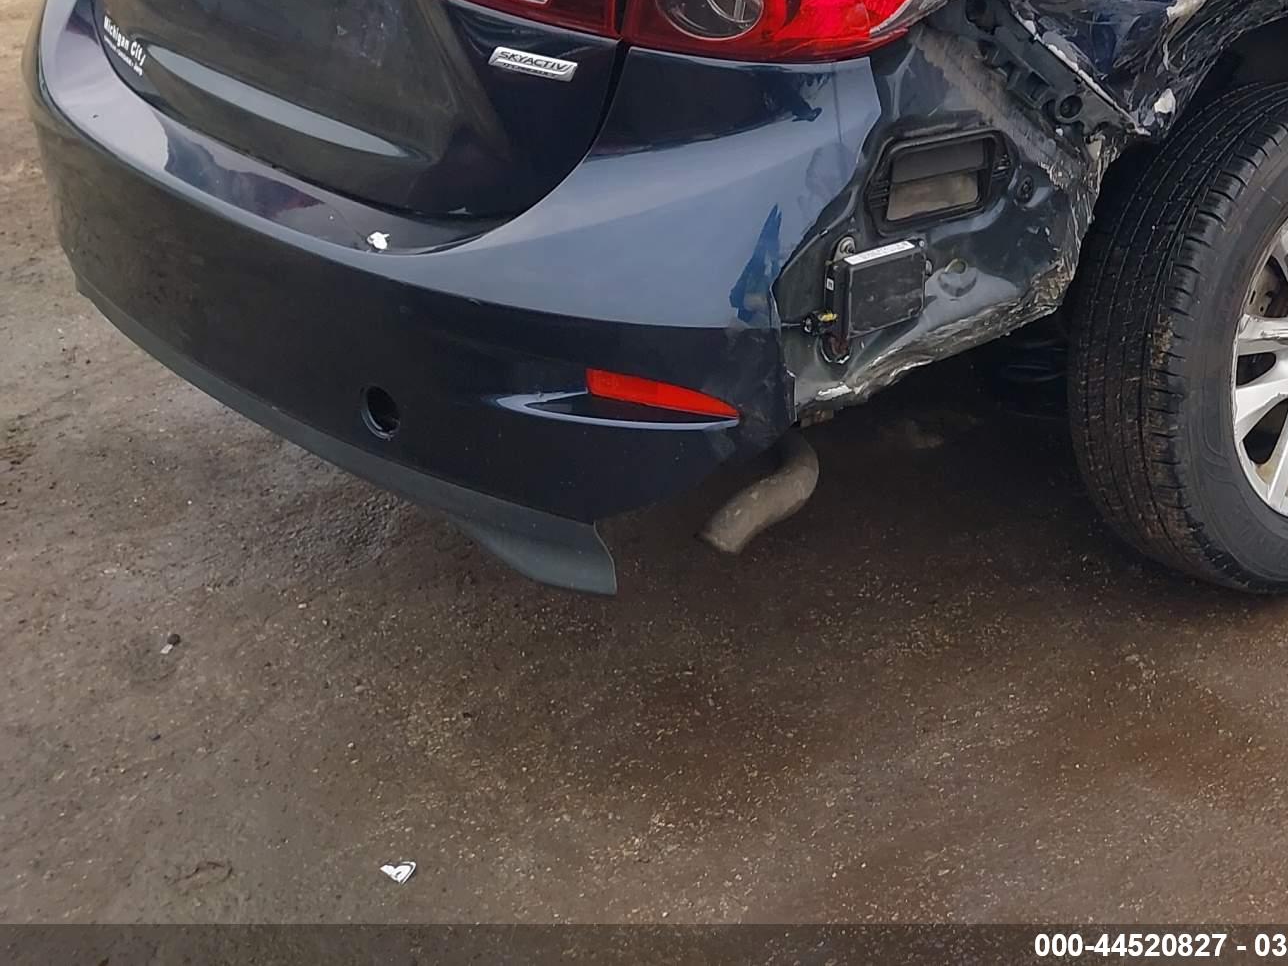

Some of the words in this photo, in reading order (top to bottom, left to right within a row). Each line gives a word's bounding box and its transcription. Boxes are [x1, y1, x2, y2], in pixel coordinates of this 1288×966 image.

[104, 15, 130, 51] Michigan
[130, 40, 146, 66] City
[497, 51, 569, 71] SKYACTIV
